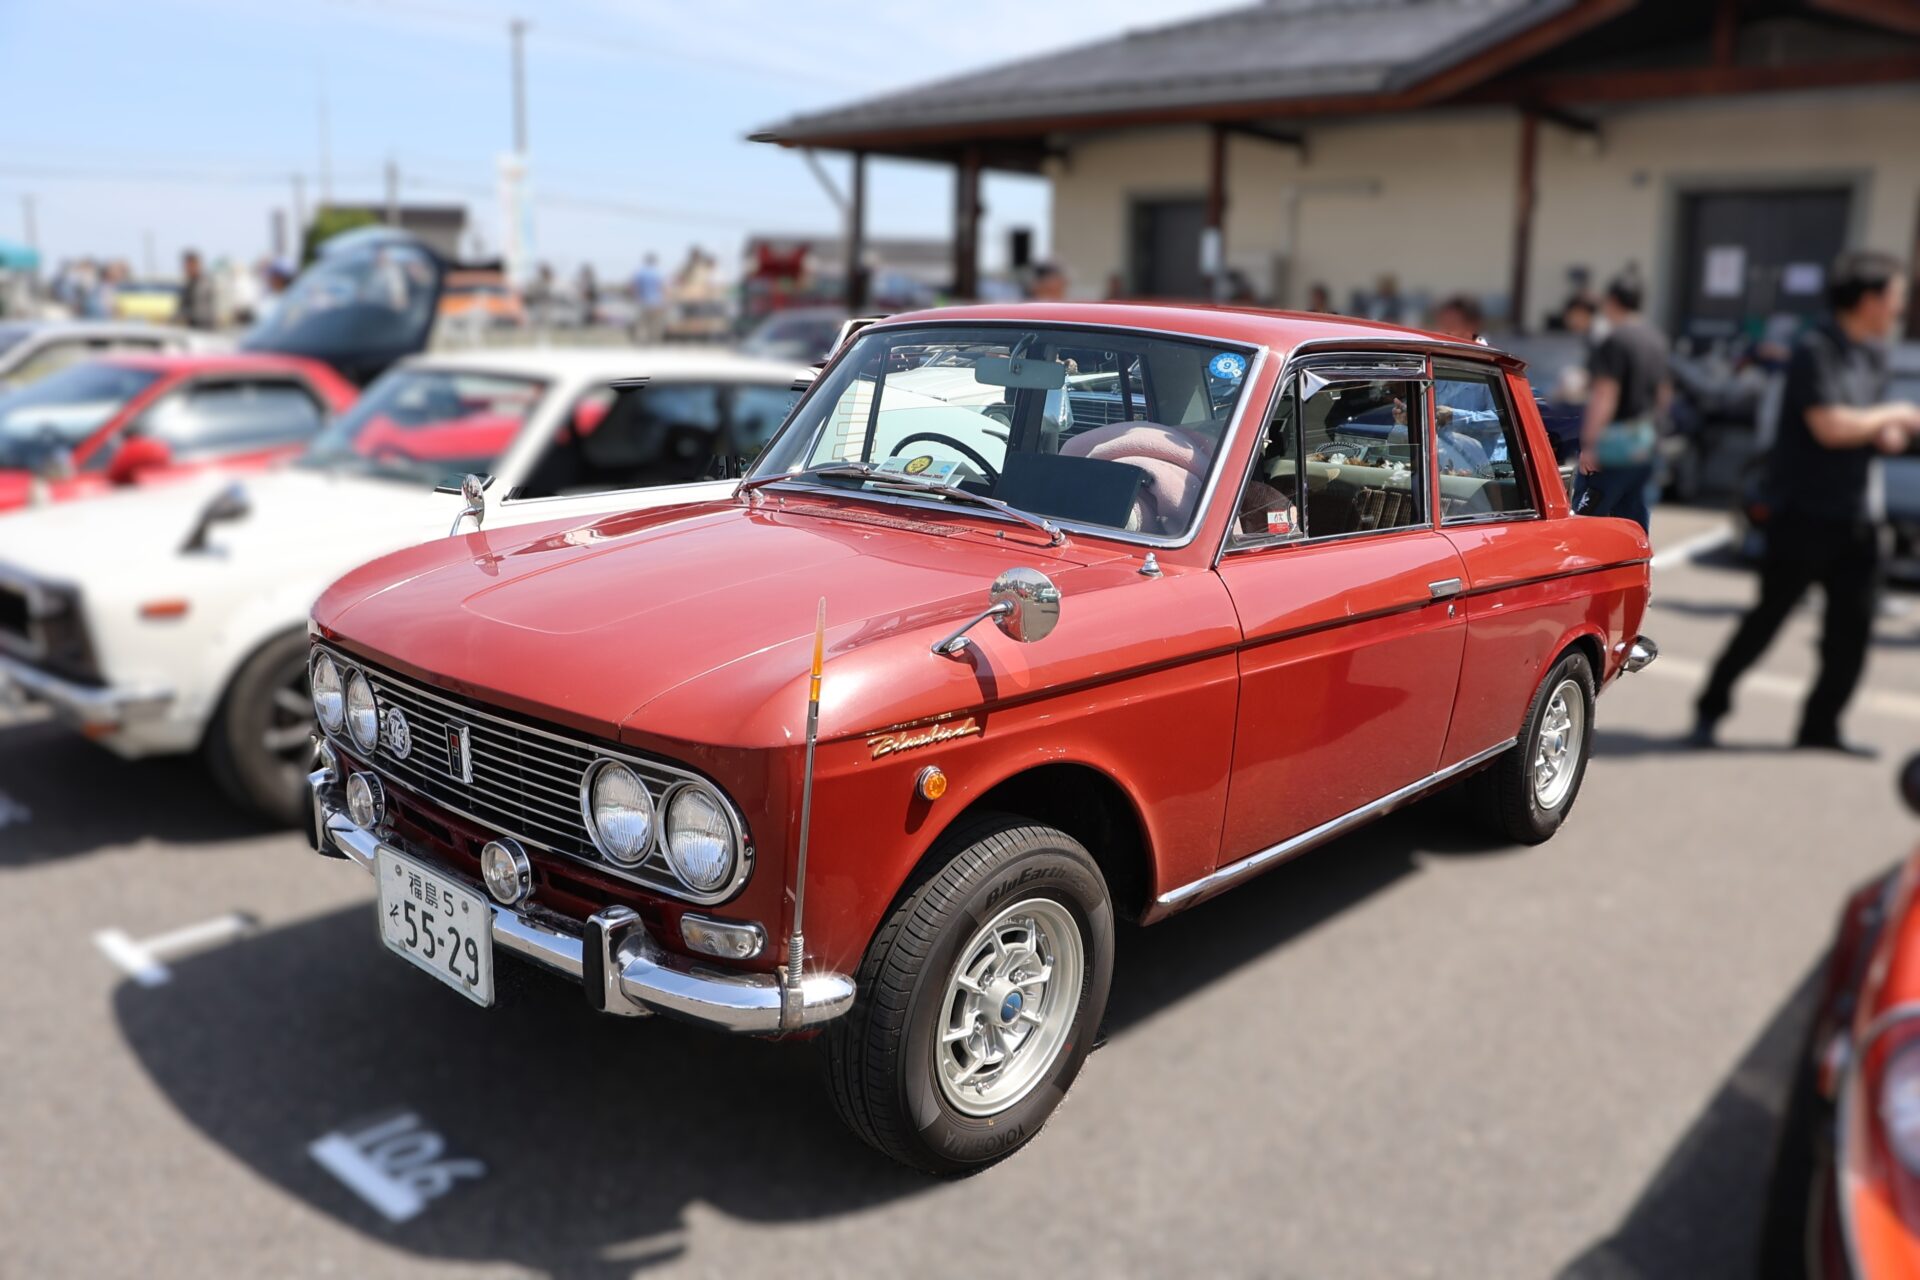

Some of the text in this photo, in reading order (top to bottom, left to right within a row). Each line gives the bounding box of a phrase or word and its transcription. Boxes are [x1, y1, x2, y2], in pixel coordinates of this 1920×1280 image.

[408, 871, 454, 917] 福島 5
[403, 899, 479, 986] 55-29
